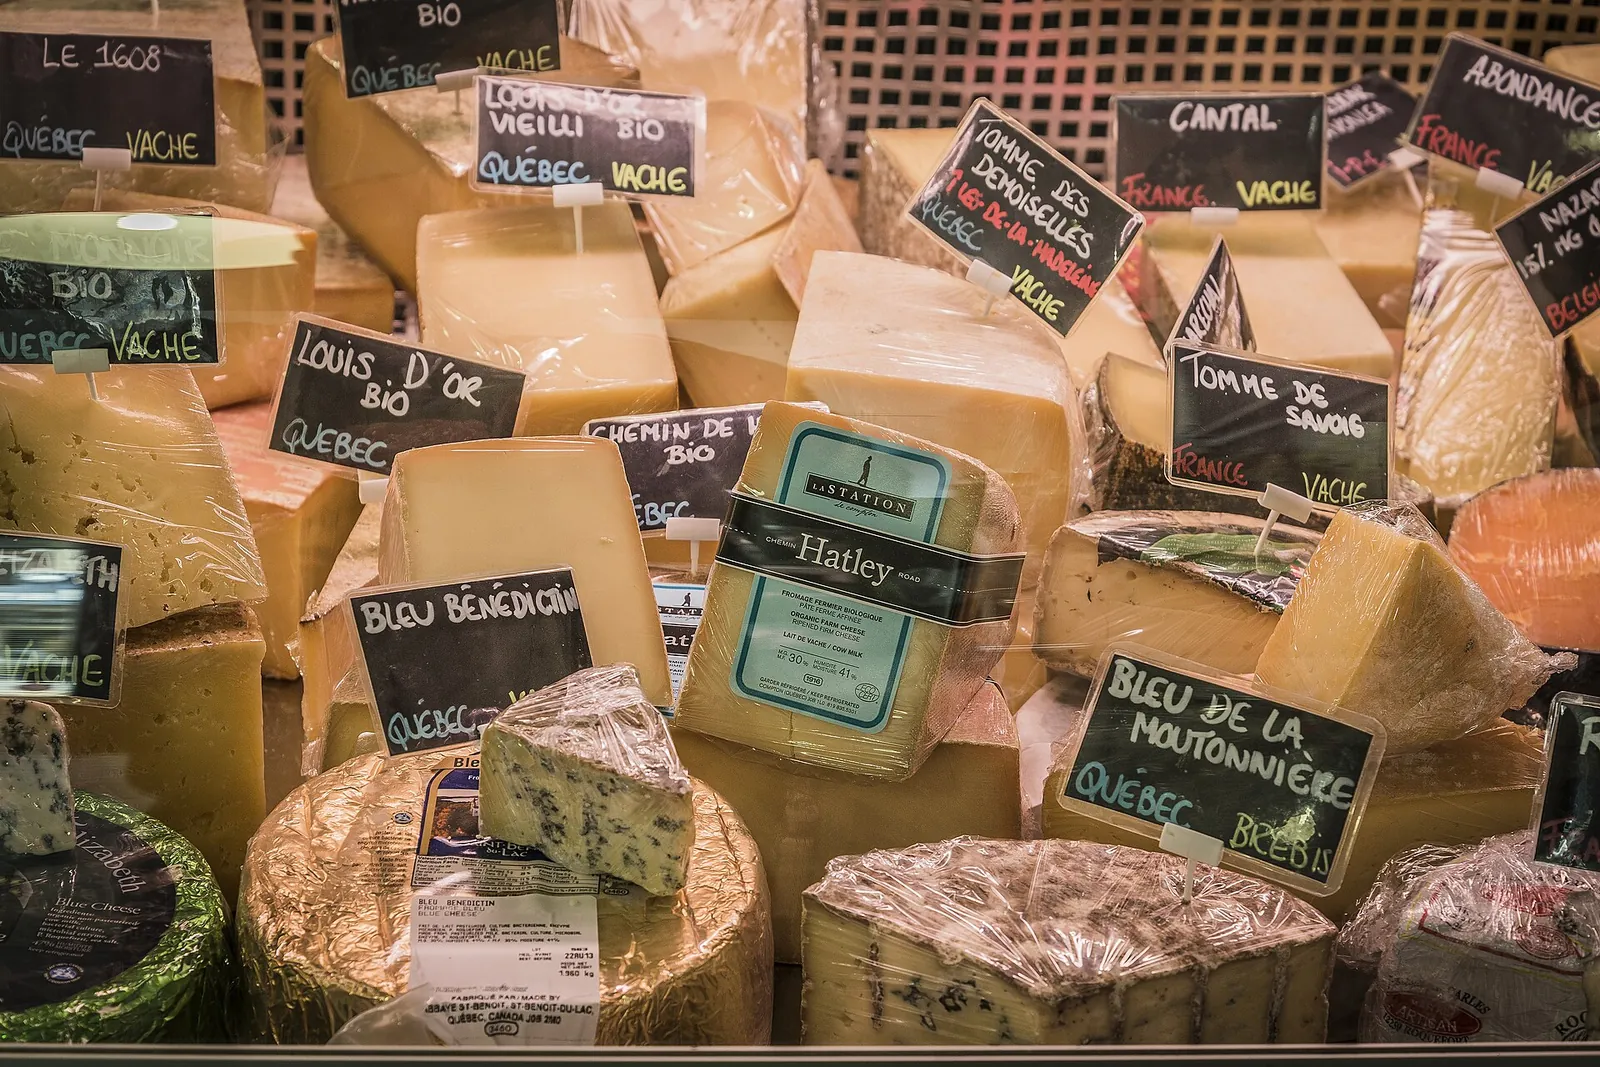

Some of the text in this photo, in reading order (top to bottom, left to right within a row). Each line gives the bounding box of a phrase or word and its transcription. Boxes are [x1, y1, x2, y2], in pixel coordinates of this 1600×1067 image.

[418, 3, 461, 27] BIO
[42, 37, 161, 73] LE 1608
[352, 45, 555, 96] QUÉBEC VACHE
[1463, 54, 1600, 130] ABONDANCE
[616, 117, 664, 141] BIO
[1169, 101, 1279, 132] CANTAL
[3, 115, 198, 160] QUÉBEC VACHE
[1416, 113, 1502, 170] FRANCE
[480, 145, 687, 192] QUÉBEC VACHE
[975, 118, 1090, 218] TOMME DES
[971, 153, 1094, 259] DEMOISELLES
[1121, 172, 1316, 207] FRANCE VACHE
[49, 268, 112, 299] BIO
[1012, 265, 1065, 321] VACHE
[109, 320, 201, 361] VACHE
[297, 329, 375, 380] LOUIS
[1180, 350, 1329, 408] TOMME DE
[360, 379, 410, 416] BIO
[282, 418, 388, 467] QUEBEC
[592, 417, 690, 443] CHEMIN
[704, 417, 734, 439] DE
[664, 441, 715, 465] BIO
[1172, 442, 1368, 504] FRANCE VACHE
[765, 536, 796, 549] CHEMIN
[795, 532, 894, 587] Hatley
[898, 571, 921, 583] ROAD
[360, 601, 435, 634] BLEU
[782, 590, 883, 623] FROMAGE FERMIER BIOLOGIQUE
[790, 610, 866, 637] ORGANIC FARM CHEESE
[799, 602, 815, 612] PÂTE
[815, 607, 836, 618] FERME
[783, 631, 797, 640] LAIT
[797, 635, 806, 643] DE
[807, 637, 828, 648] VACHE
[832, 644, 847, 653] COW
[847, 648, 864, 658] MILK
[792, 618, 860, 643] RIPENED FIRM CHEESE
[4, 639, 104, 687] VACHE
[1108, 659, 1304, 749] BLEU DE LA
[388, 698, 476, 751] QUÉBEC
[1130, 711, 1354, 810] MOUTONNIÈRE
[1075, 761, 1193, 829] QUÉBEC
[74, 816, 146, 894] lizabeth
[55, 897, 142, 915] Blue Cheese
[418, 898, 496, 907] BLEU BENEDICTIN
[584, 970, 595, 978] kg
[488, 1012, 524, 1023] CANADA
[1395, 1005, 1458, 1033] ARTISAN
